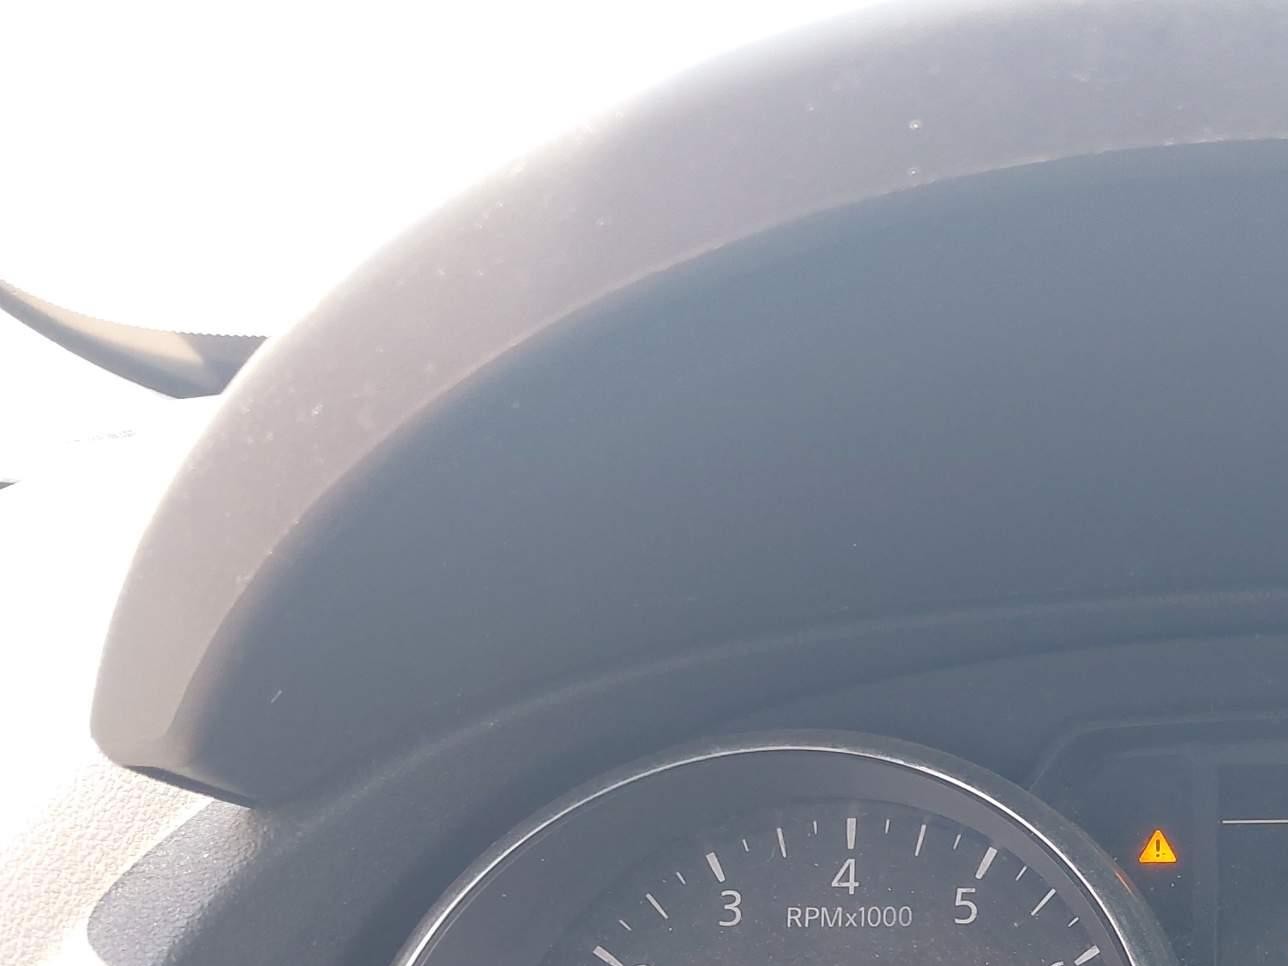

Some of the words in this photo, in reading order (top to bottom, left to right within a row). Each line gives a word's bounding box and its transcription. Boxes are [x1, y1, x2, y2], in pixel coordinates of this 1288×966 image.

[831, 858, 858, 894] 4
[719, 890, 742, 926] 3
[786, 906, 912, 928] RPMx1000
[954, 888, 977, 924] 5
